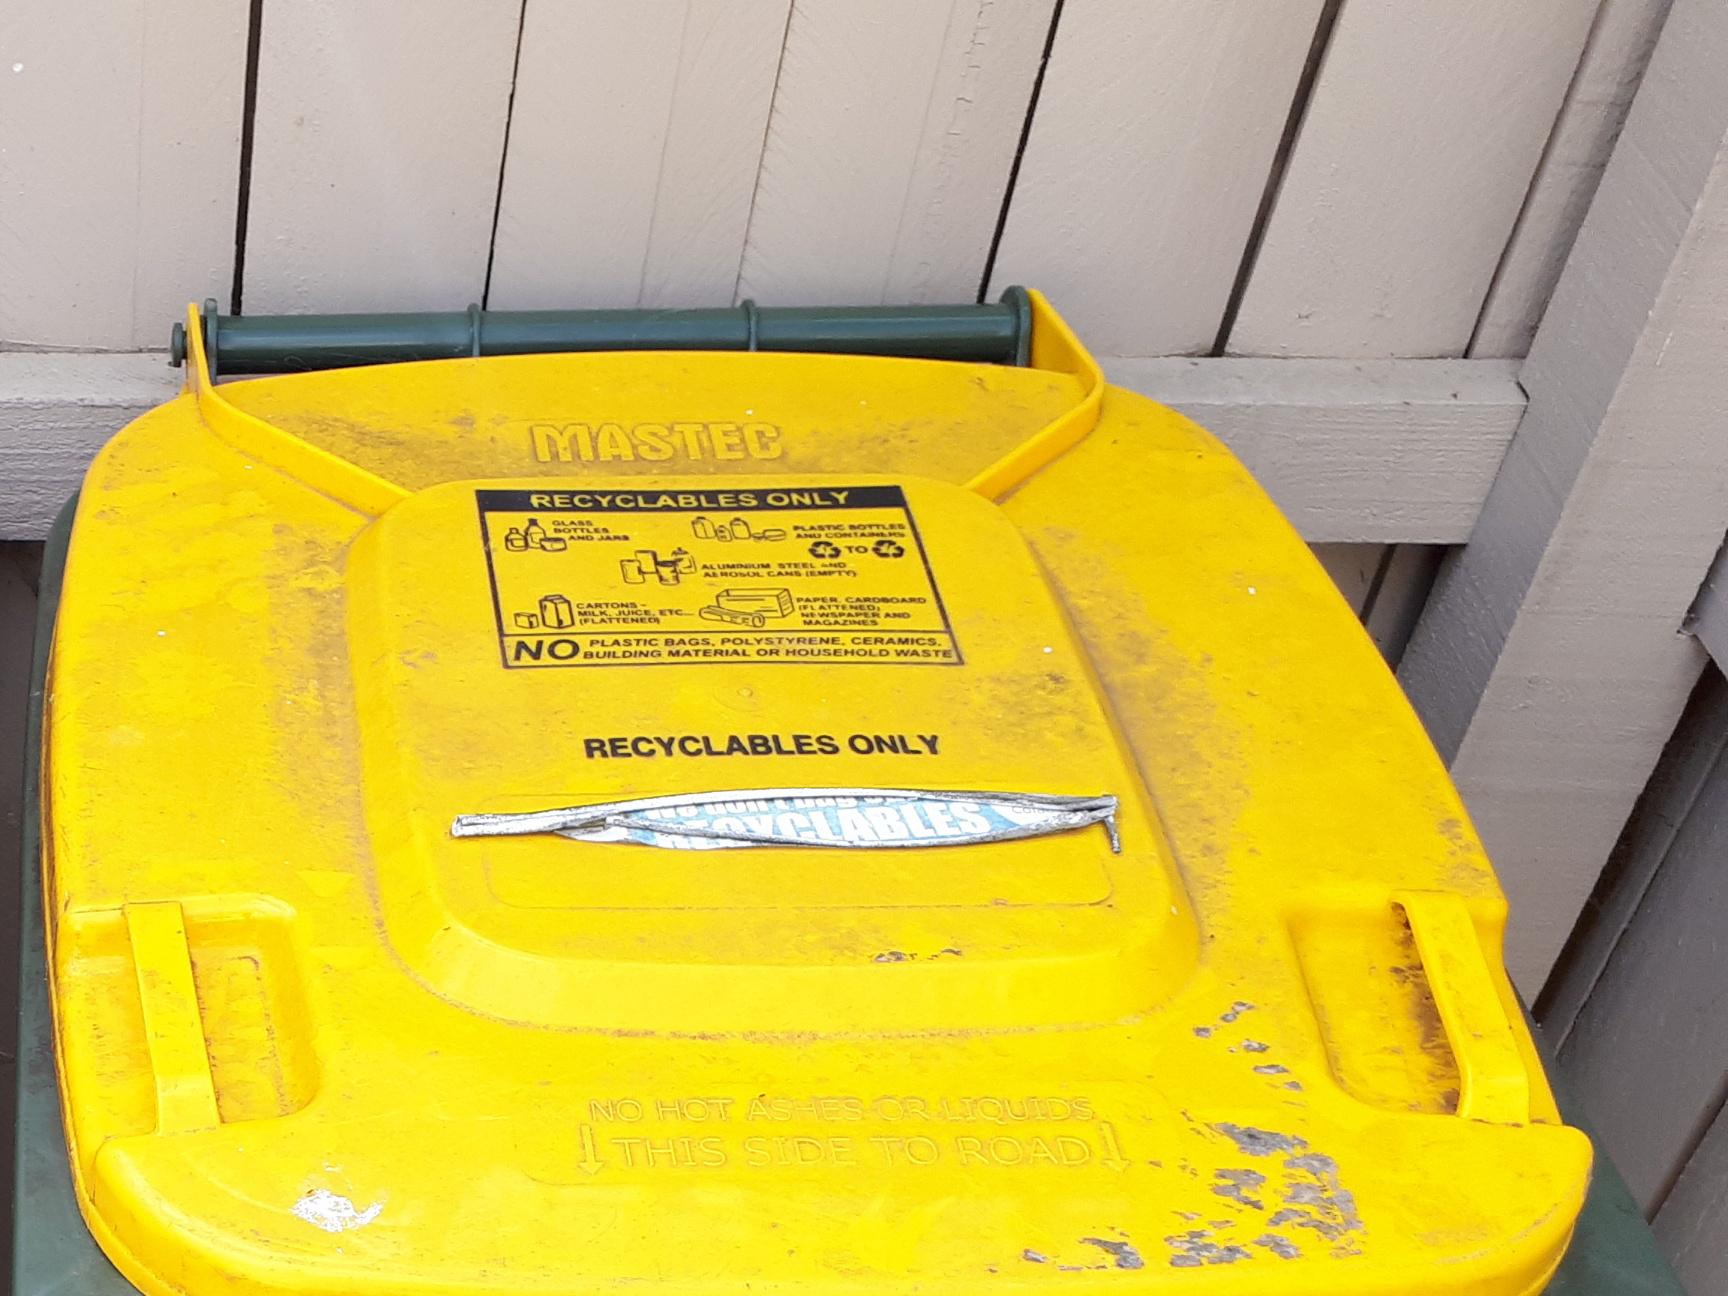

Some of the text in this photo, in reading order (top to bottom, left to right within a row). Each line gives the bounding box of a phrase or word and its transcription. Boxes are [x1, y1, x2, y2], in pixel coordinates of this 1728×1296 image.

[530, 421, 784, 463] MASTEC
[529, 490, 850, 509] RECYCLABLES ONLY
[551, 519, 593, 527] GLASS
[825, 531, 906, 539] CONTAINERS
[844, 545, 869, 554] TO
[703, 570, 764, 578] AEROSOL
[805, 569, 858, 578] (EMPTY)
[844, 596, 928, 604] CARDBOARD
[575, 602, 638, 610] CARTONS
[800, 611, 912, 619] NEWSPAPER AND
[579, 617, 661, 626] (FLATTENED)
[589, 636, 942, 647] PLASTIC BAGS, POLYSTYRENE, CERAMICS,
[513, 638, 581, 662] NO
[582, 648, 953, 660] BUILDING MATERIAL OR HOUSEHOLD WASTE
[583, 733, 942, 760] RECYCLABLES ONLY
[588, 1096, 1096, 1125] NO HOT ASHES OR LIQUIDS
[610, 1136, 1092, 1167] THIS SIDE TO ROAD
